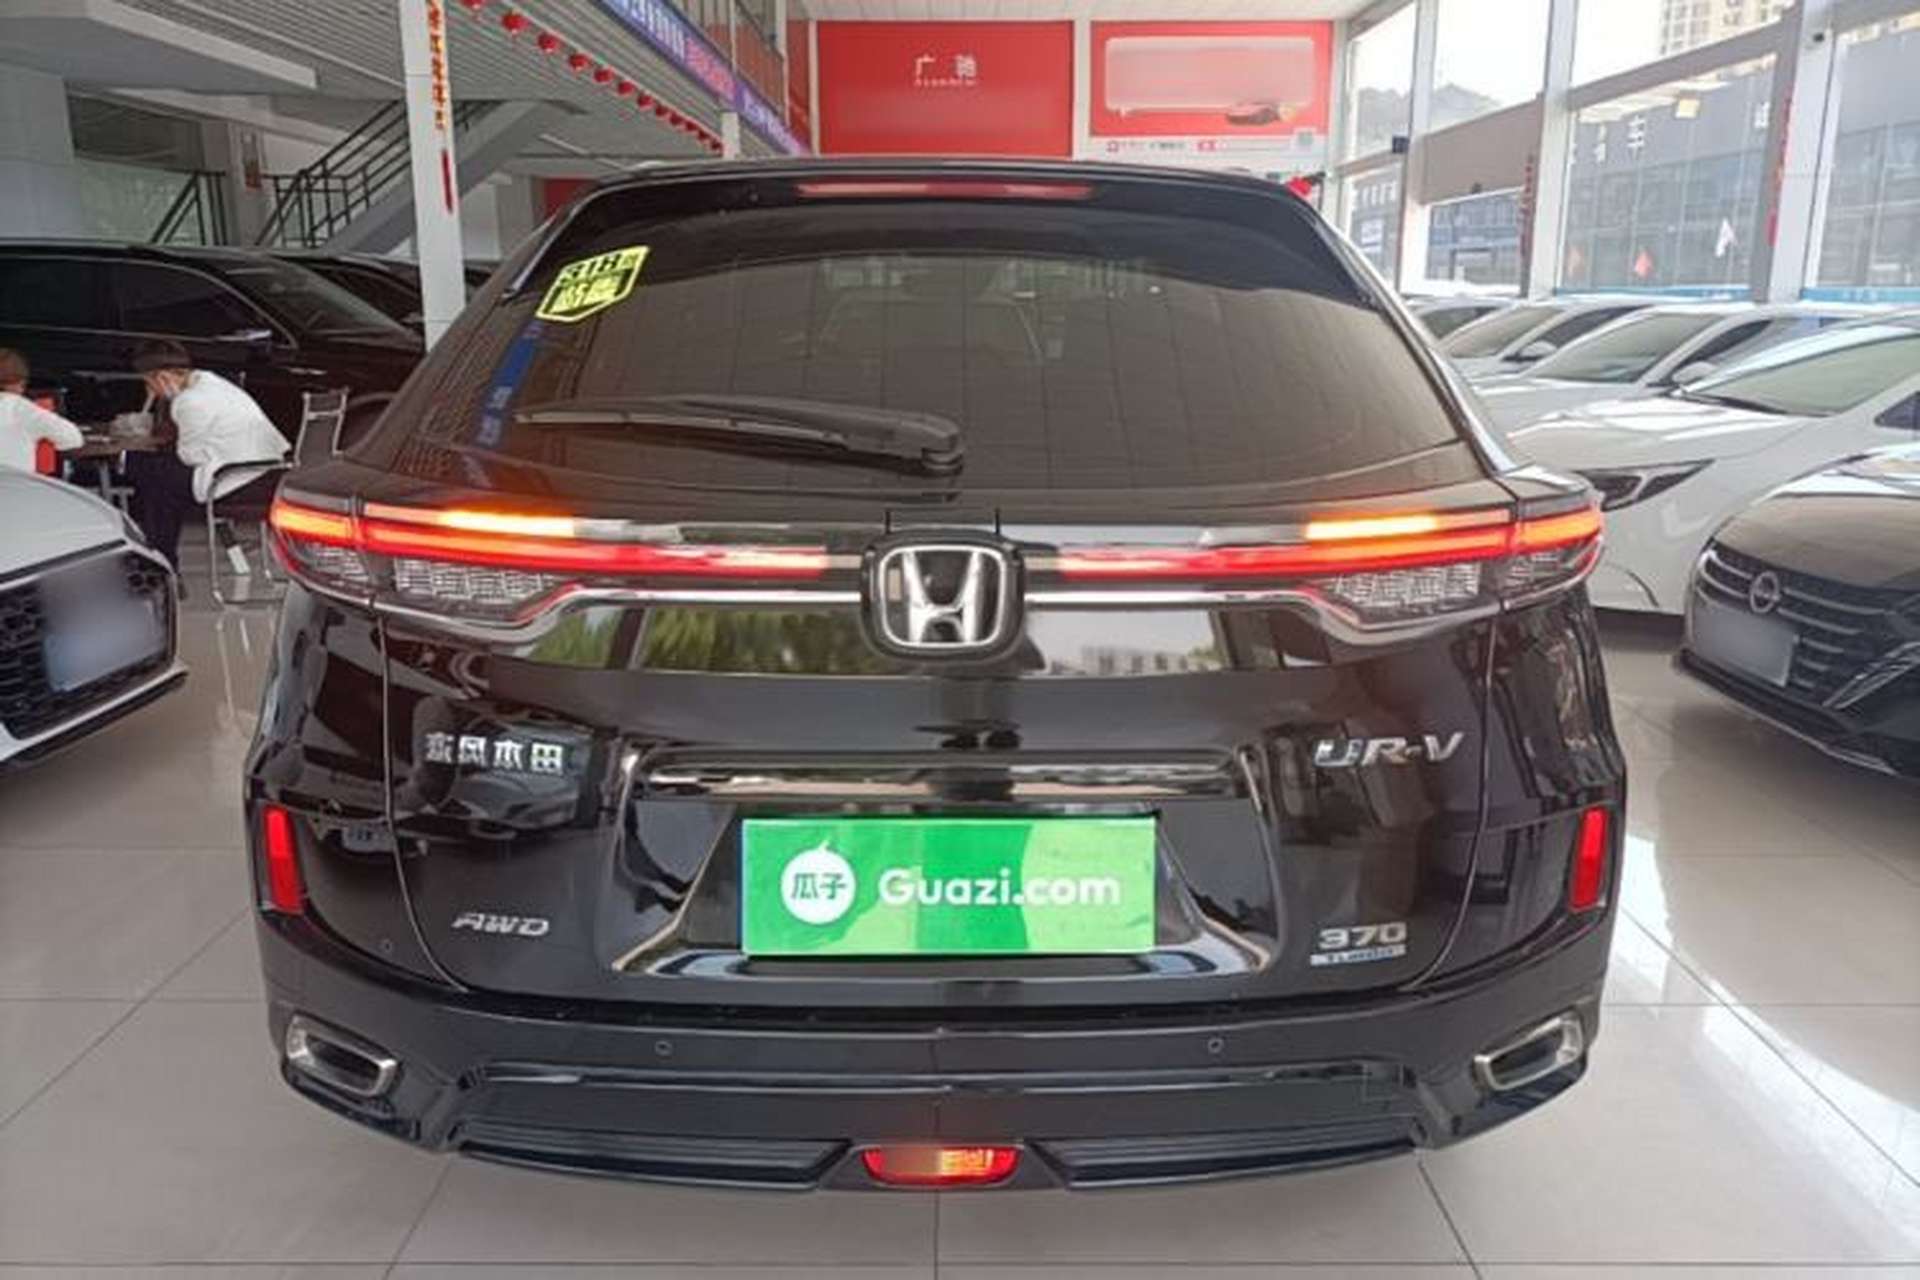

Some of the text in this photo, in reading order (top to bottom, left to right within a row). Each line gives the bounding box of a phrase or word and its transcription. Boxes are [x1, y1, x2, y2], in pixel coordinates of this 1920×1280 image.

[1314, 731, 1465, 767] UR-V
[450, 912, 550, 937] AWD
[1319, 921, 1407, 950] 370
